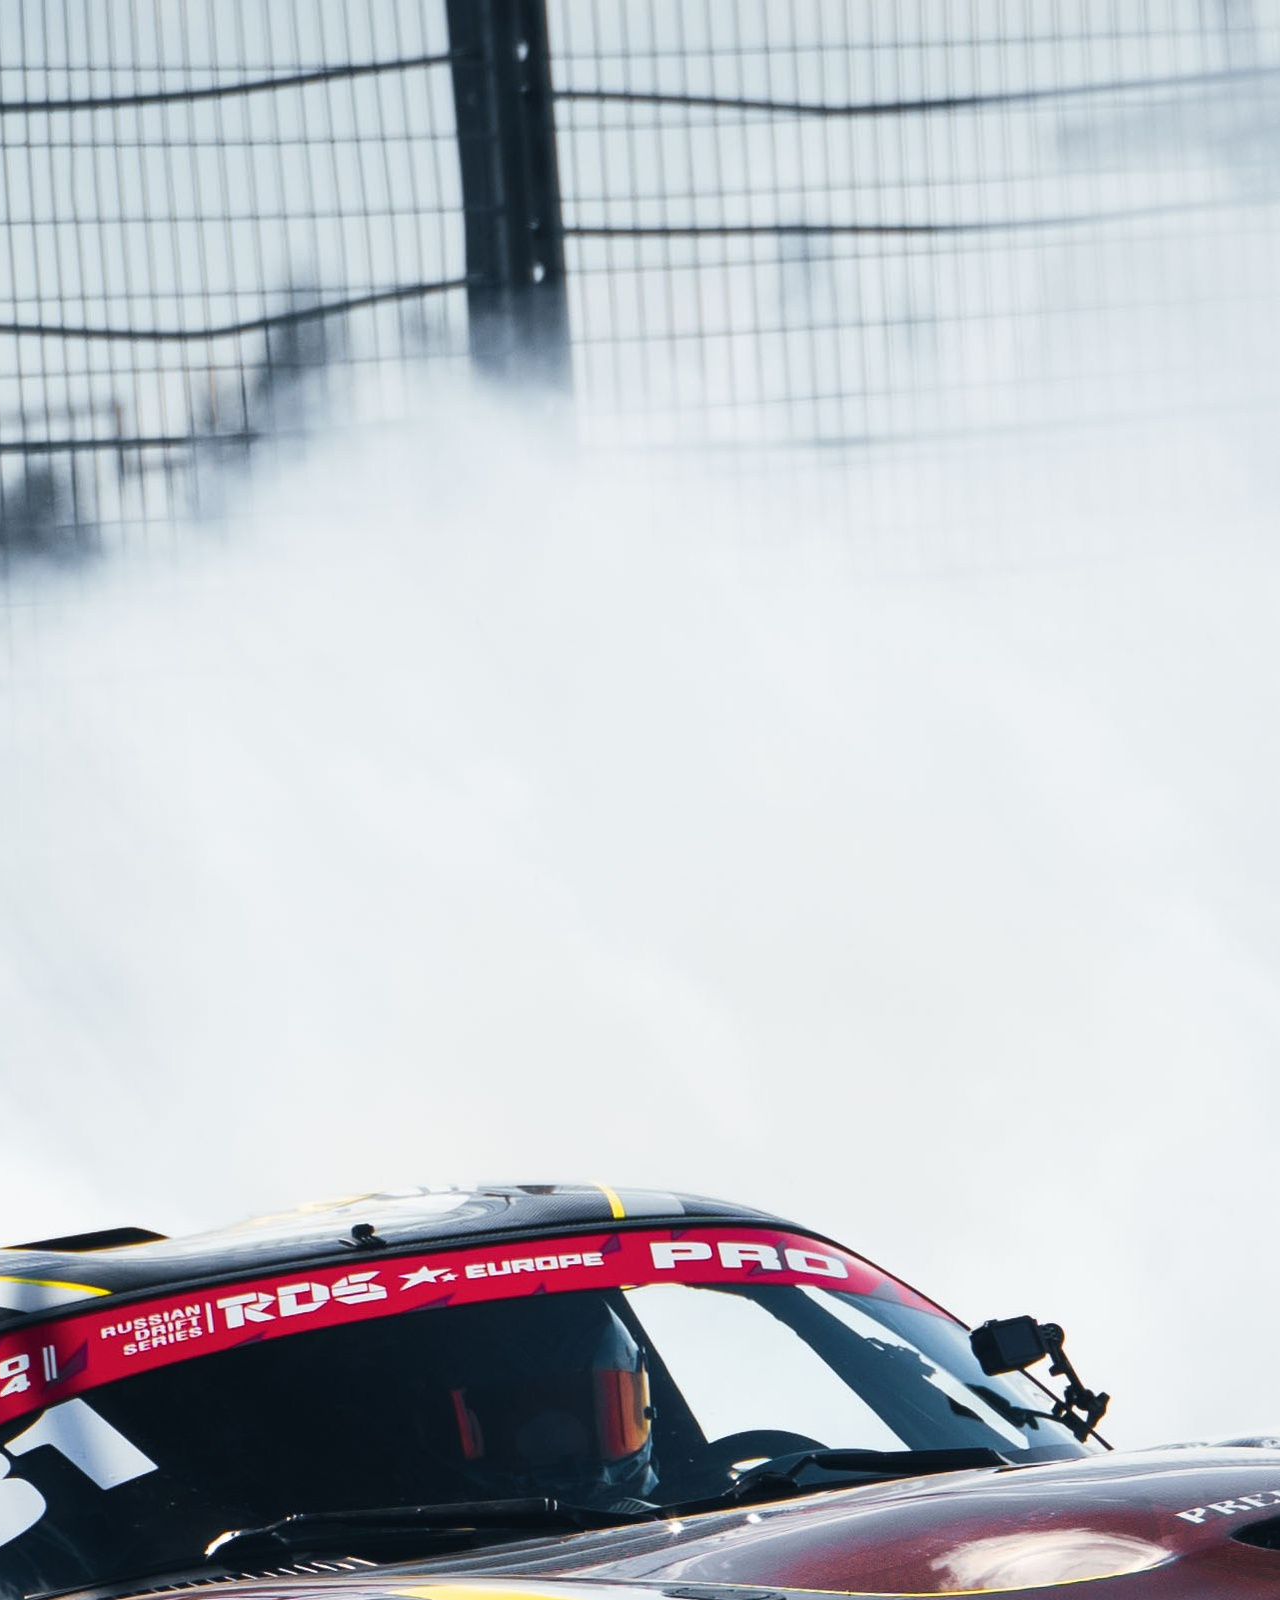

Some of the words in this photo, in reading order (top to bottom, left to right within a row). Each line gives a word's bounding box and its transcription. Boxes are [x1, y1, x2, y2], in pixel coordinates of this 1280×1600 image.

[649, 1241, 849, 1280] PRO
[216, 1271, 388, 1329] RDS
[464, 1252, 604, 1279] EUROPE
[100, 1304, 201, 1339] RUSSIAN
[134, 1315, 200, 1341] DRIFT
[123, 1326, 203, 1356] SERIES
